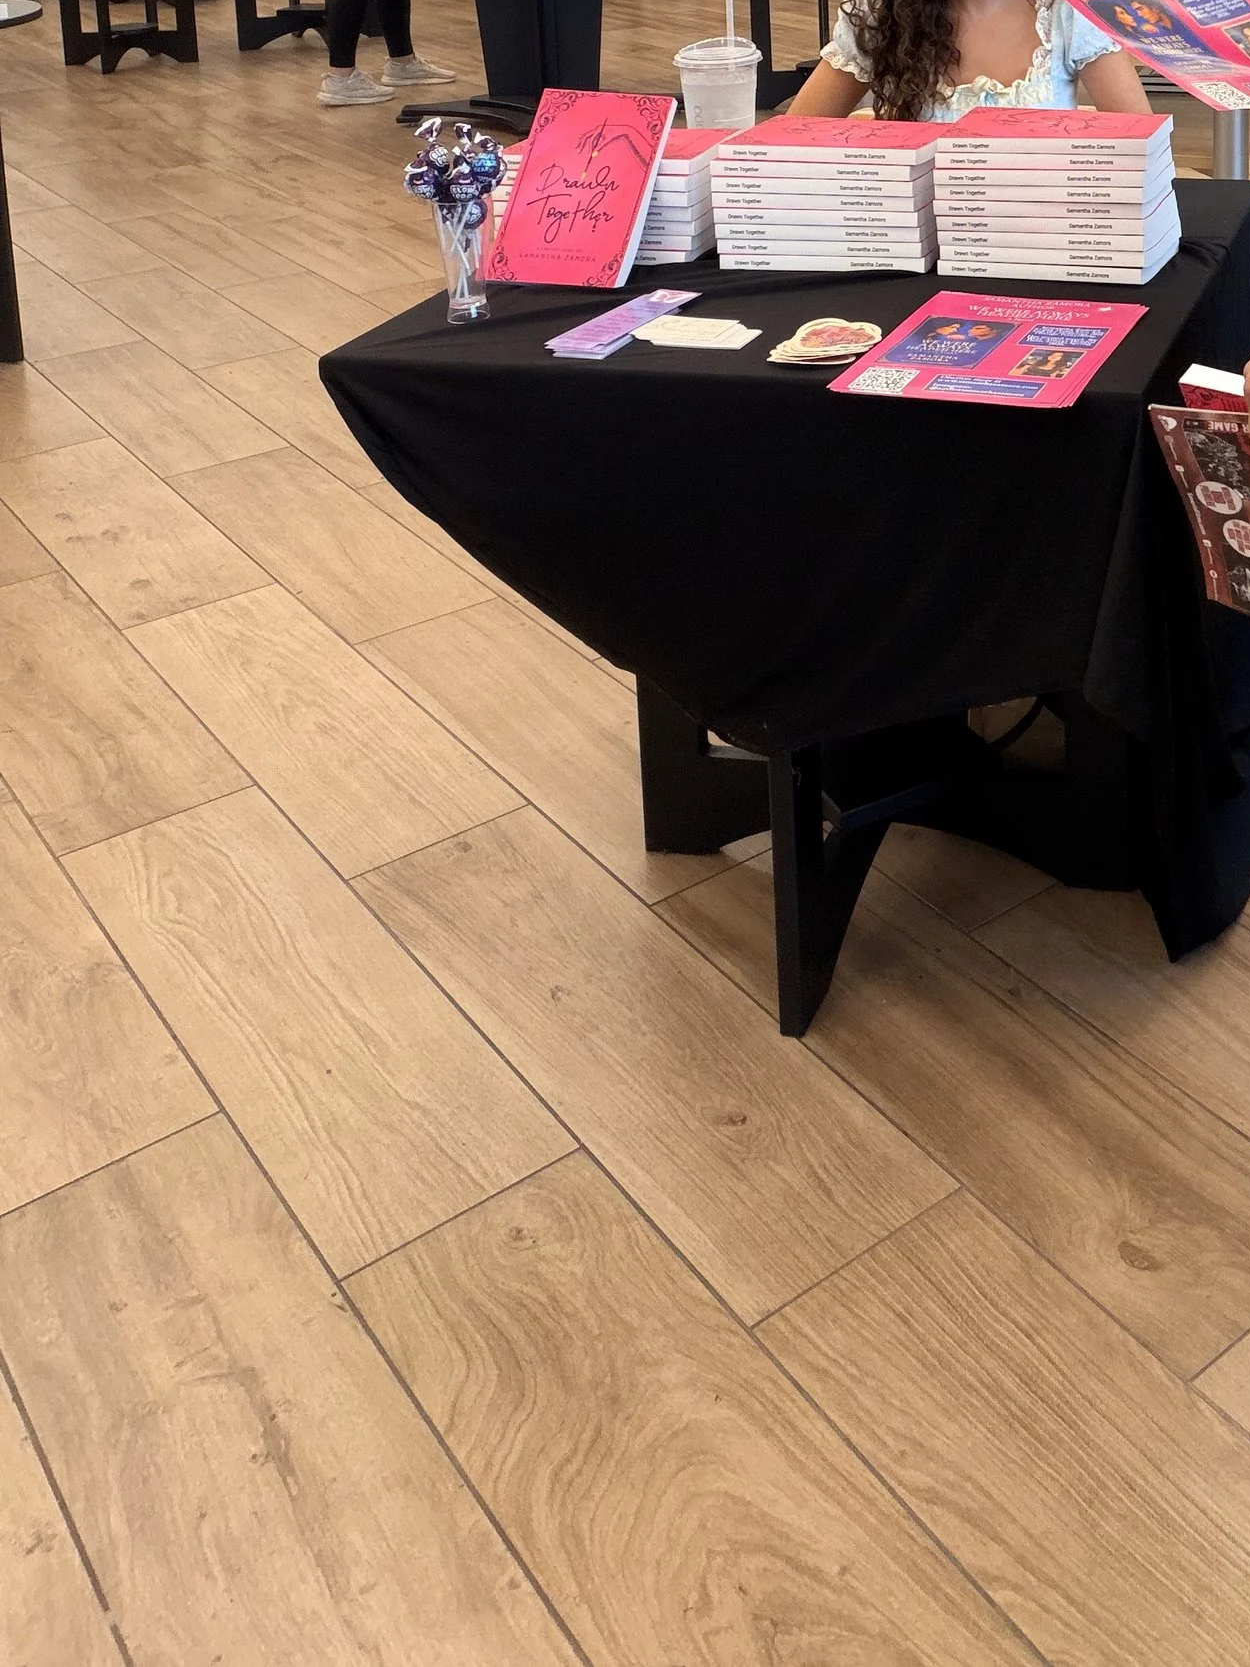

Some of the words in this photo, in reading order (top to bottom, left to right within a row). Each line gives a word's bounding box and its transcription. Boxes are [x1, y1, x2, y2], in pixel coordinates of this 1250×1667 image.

[536, 162, 619, 194] Drawn
[526, 190, 614, 243] Together
[968, 266, 987, 274] Together
[1066, 271, 1091, 279] Samantha
